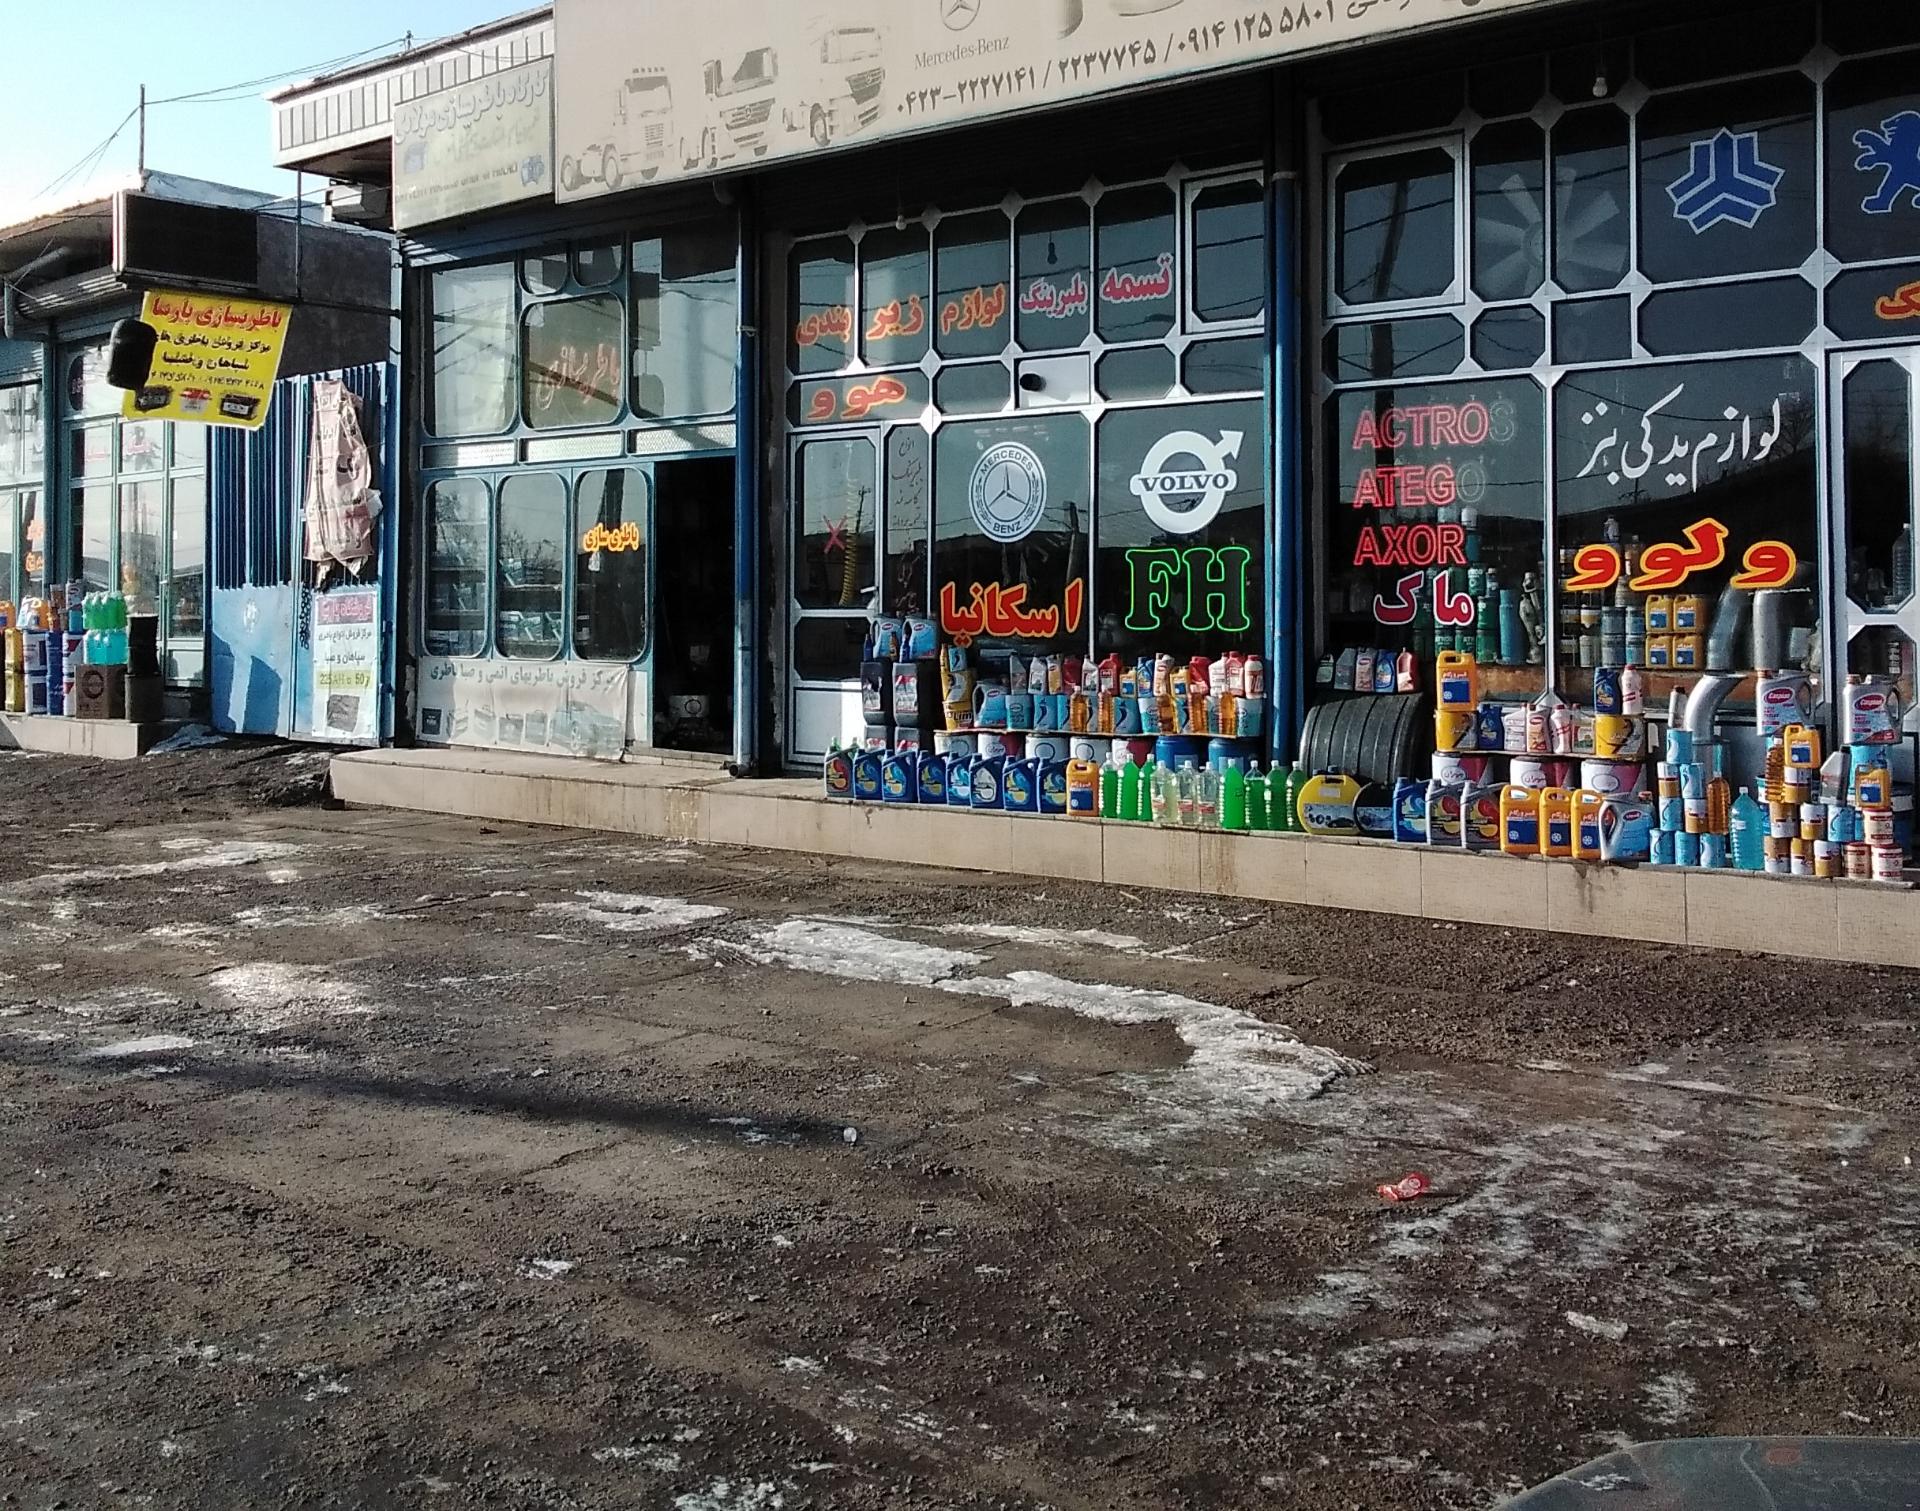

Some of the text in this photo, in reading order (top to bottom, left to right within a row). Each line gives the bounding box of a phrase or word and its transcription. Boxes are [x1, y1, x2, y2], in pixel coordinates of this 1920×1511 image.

[914, 36, 1010, 70] Mercedes-Benz
[796, 252, 1174, 346] تسمه بلبرینگ لوازم زیر بندی
[1352, 401, 1515, 450] ACTROS
[1576, 382, 1781, 493] لوازم یدکی بنز
[980, 450, 1034, 475] MERCEDES
[1139, 473, 1229, 492] VOLVO
[1352, 463, 1486, 508] ATEGO
[993, 522, 1022, 534] BENZ
[1353, 524, 1467, 566] AXOR
[1125, 546, 1250, 631] FH
